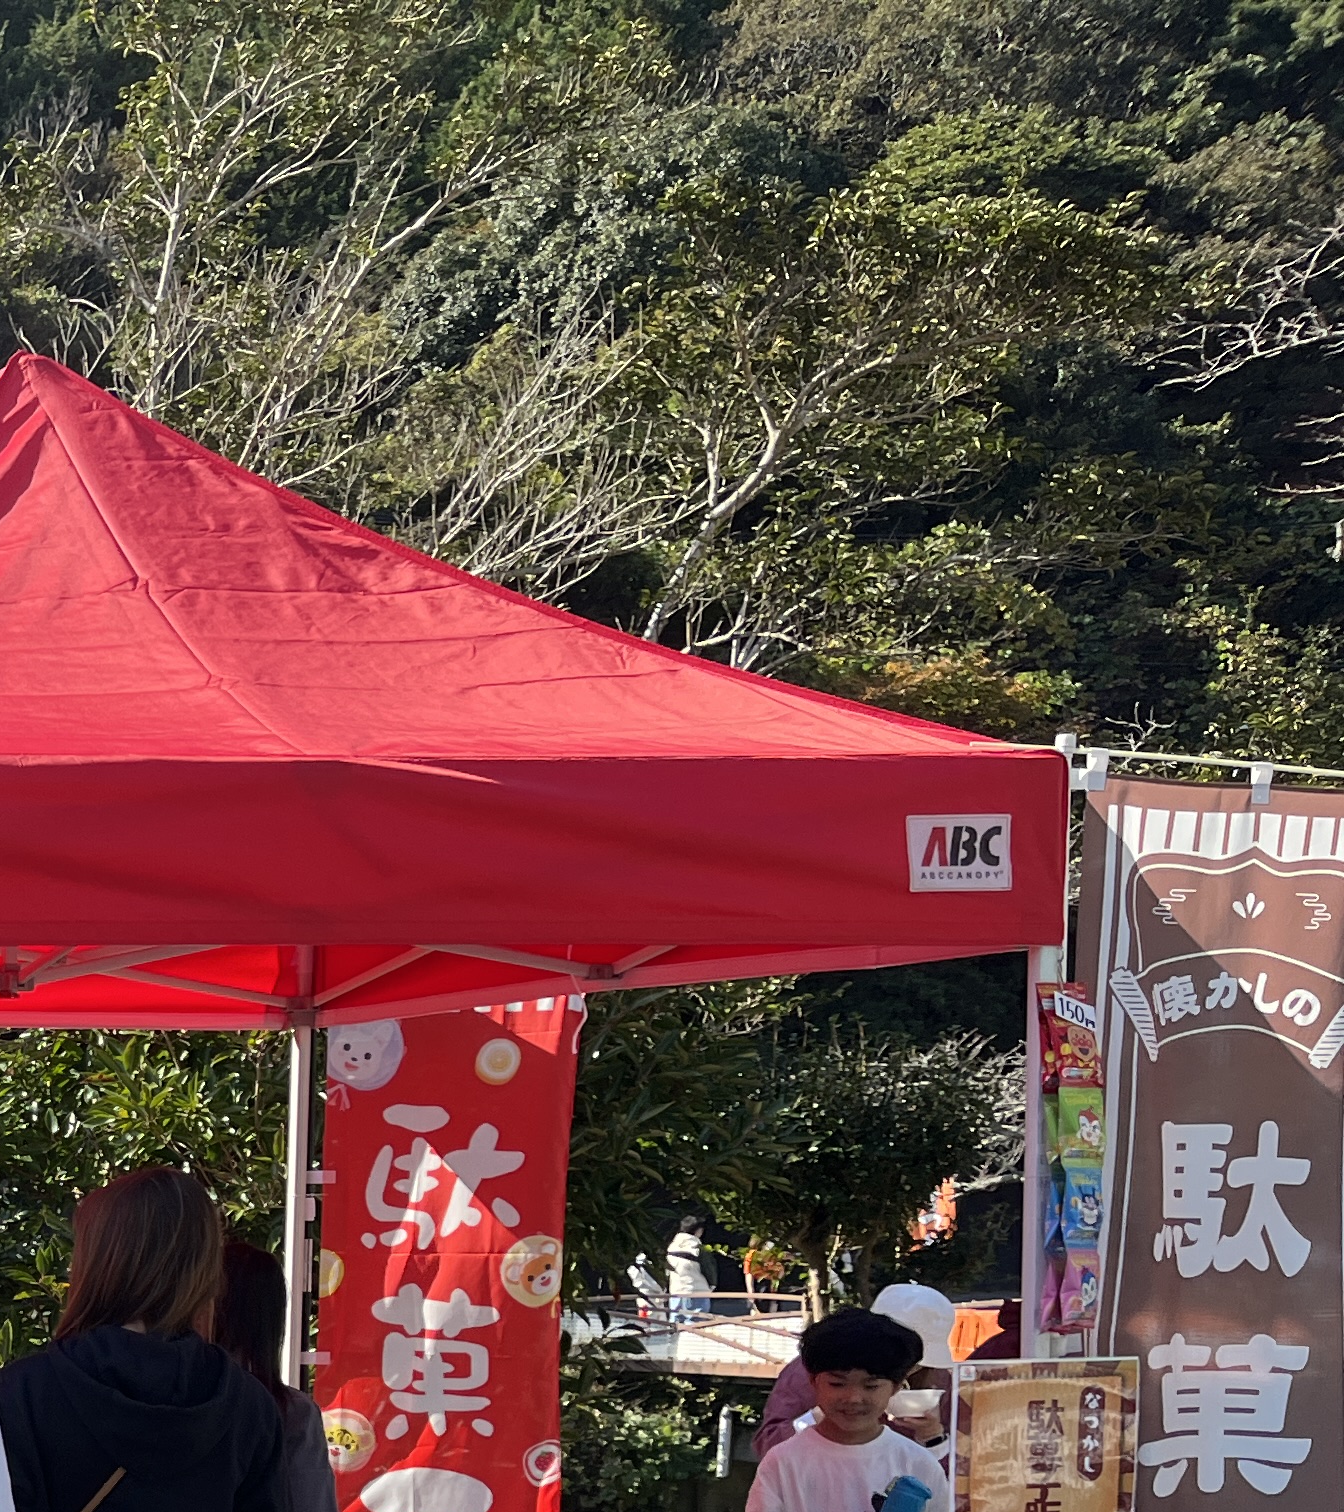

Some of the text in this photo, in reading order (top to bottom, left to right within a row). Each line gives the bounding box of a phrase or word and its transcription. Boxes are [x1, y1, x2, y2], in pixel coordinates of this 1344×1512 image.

[921, 825, 1002, 867] ABC
[920, 871, 1000, 880] ABCCANOPY
[1058, 997, 1096, 1029] 150円
[1152, 971, 1321, 1027] 懐かしの
[1081, 1391, 1102, 1473] なつかし
